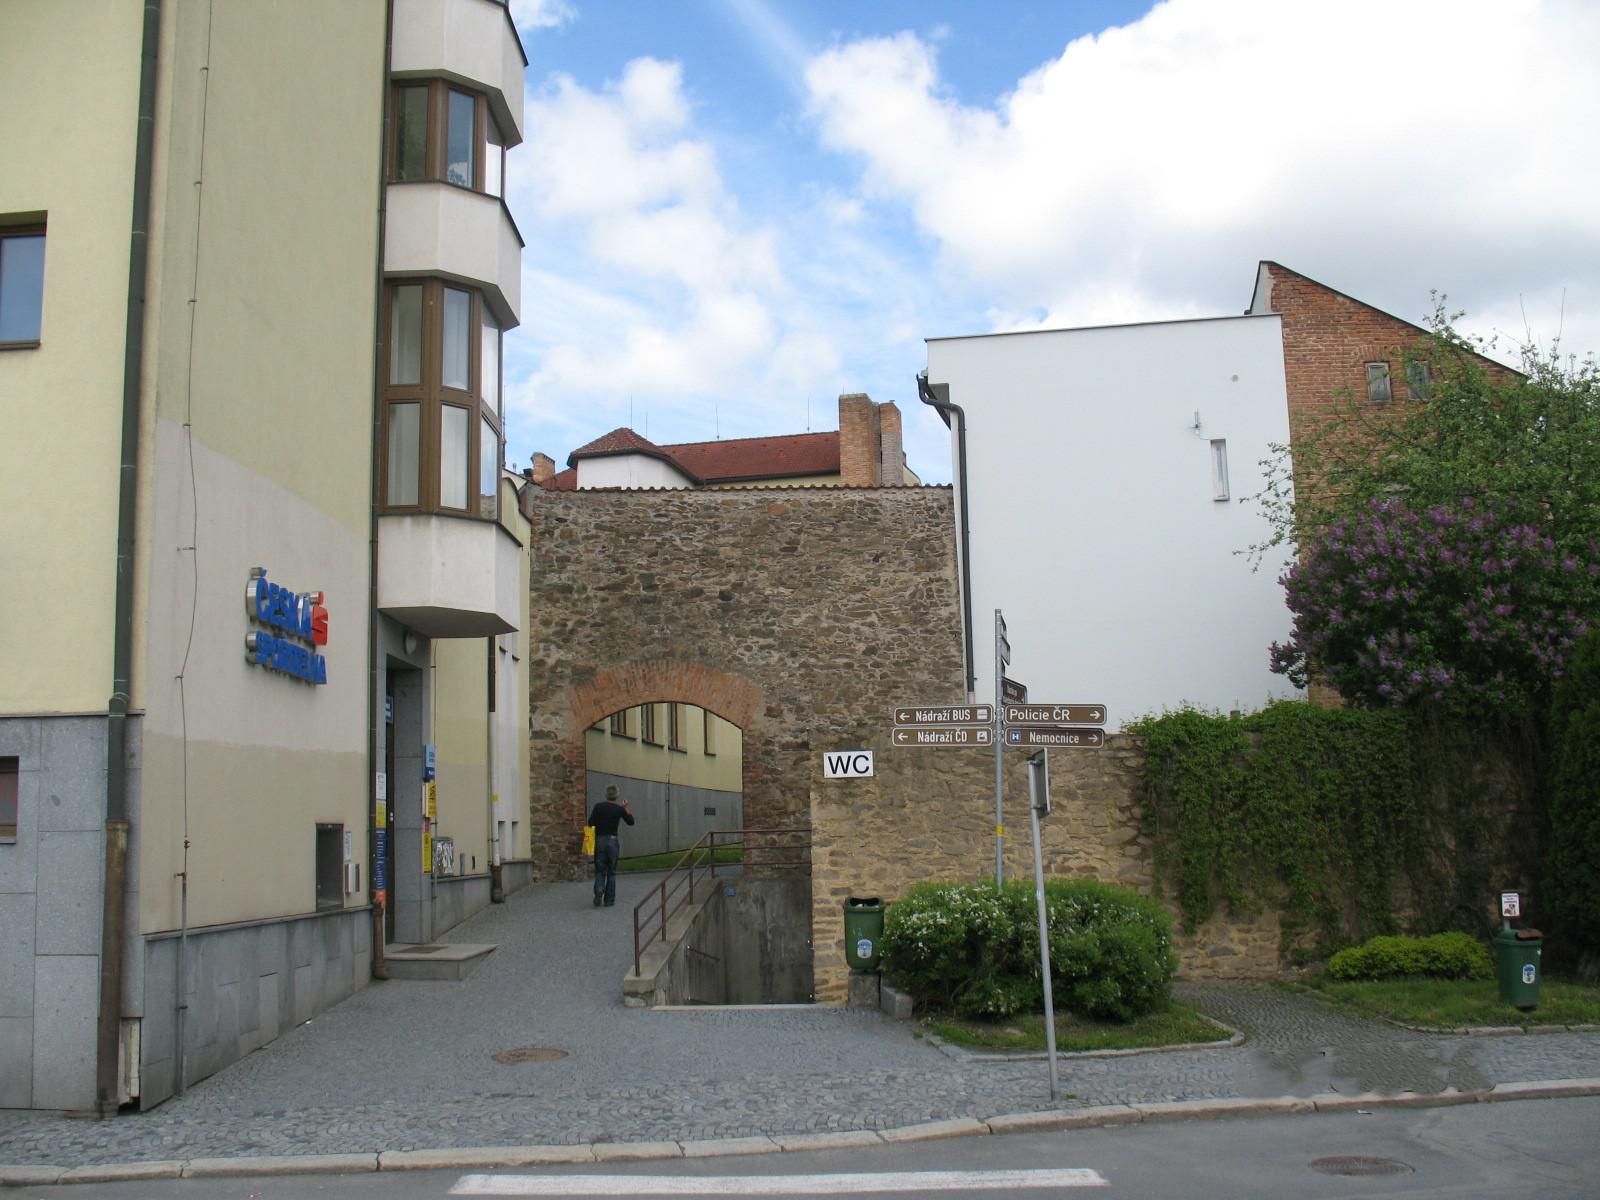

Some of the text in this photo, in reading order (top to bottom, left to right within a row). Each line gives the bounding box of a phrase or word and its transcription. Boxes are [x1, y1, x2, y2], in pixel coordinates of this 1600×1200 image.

[915, 709, 971, 722] Nádraží BUS
[1009, 705, 1070, 721] Policie ČR
[917, 728, 968, 743] Nádraží ČD
[1029, 731, 1080, 744] Nemocnice
[828, 754, 870, 775] WC
